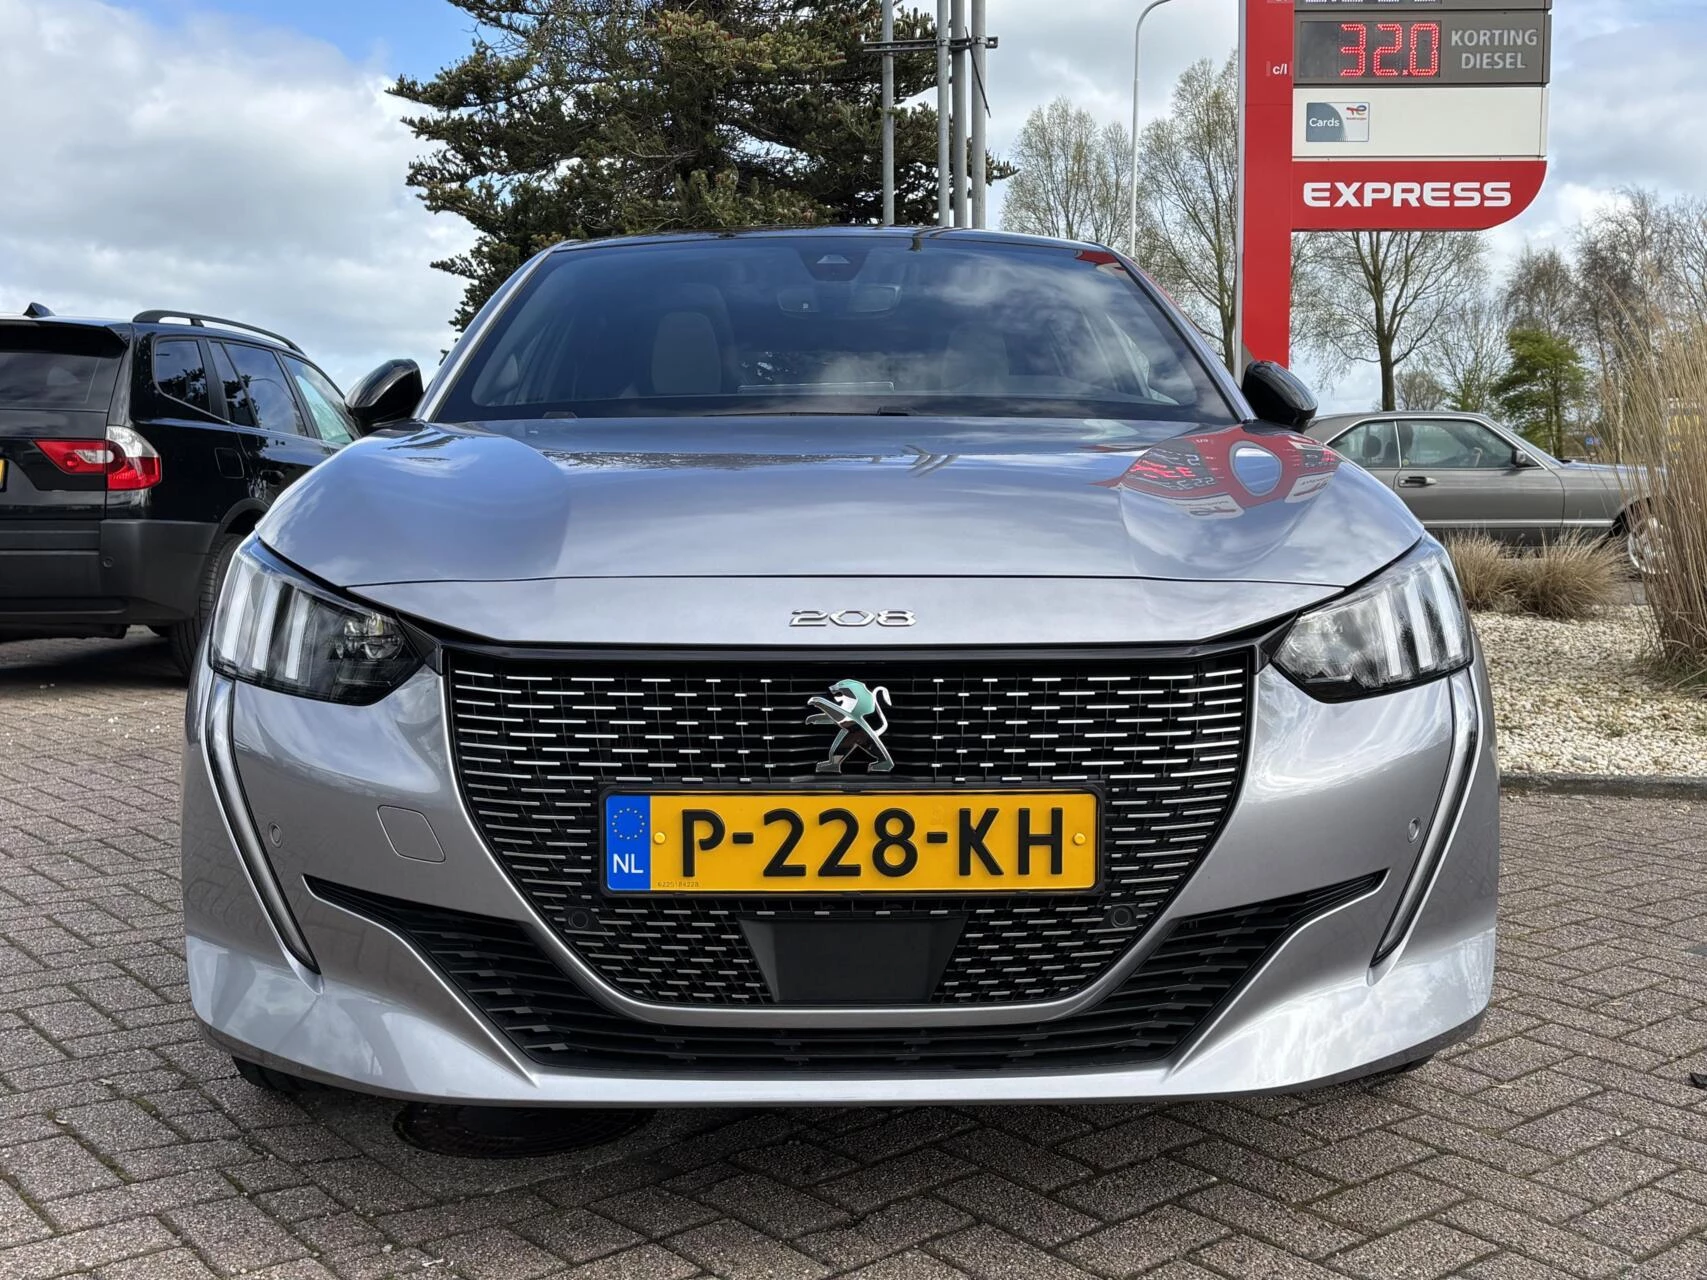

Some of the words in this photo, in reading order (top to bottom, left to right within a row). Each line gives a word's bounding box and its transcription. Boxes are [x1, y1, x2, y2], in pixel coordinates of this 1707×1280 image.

[1451, 29, 1538, 46] KORTING
[1340, 23, 1439, 76] 32.0
[1461, 52, 1526, 69] DIESEL
[1309, 117, 1340, 127] Cards
[1303, 181, 1512, 207] EXPRESS
[789, 609, 917, 627] 208
[681, 807, 1064, 878] P-228-KH
[612, 853, 644, 875] NL
